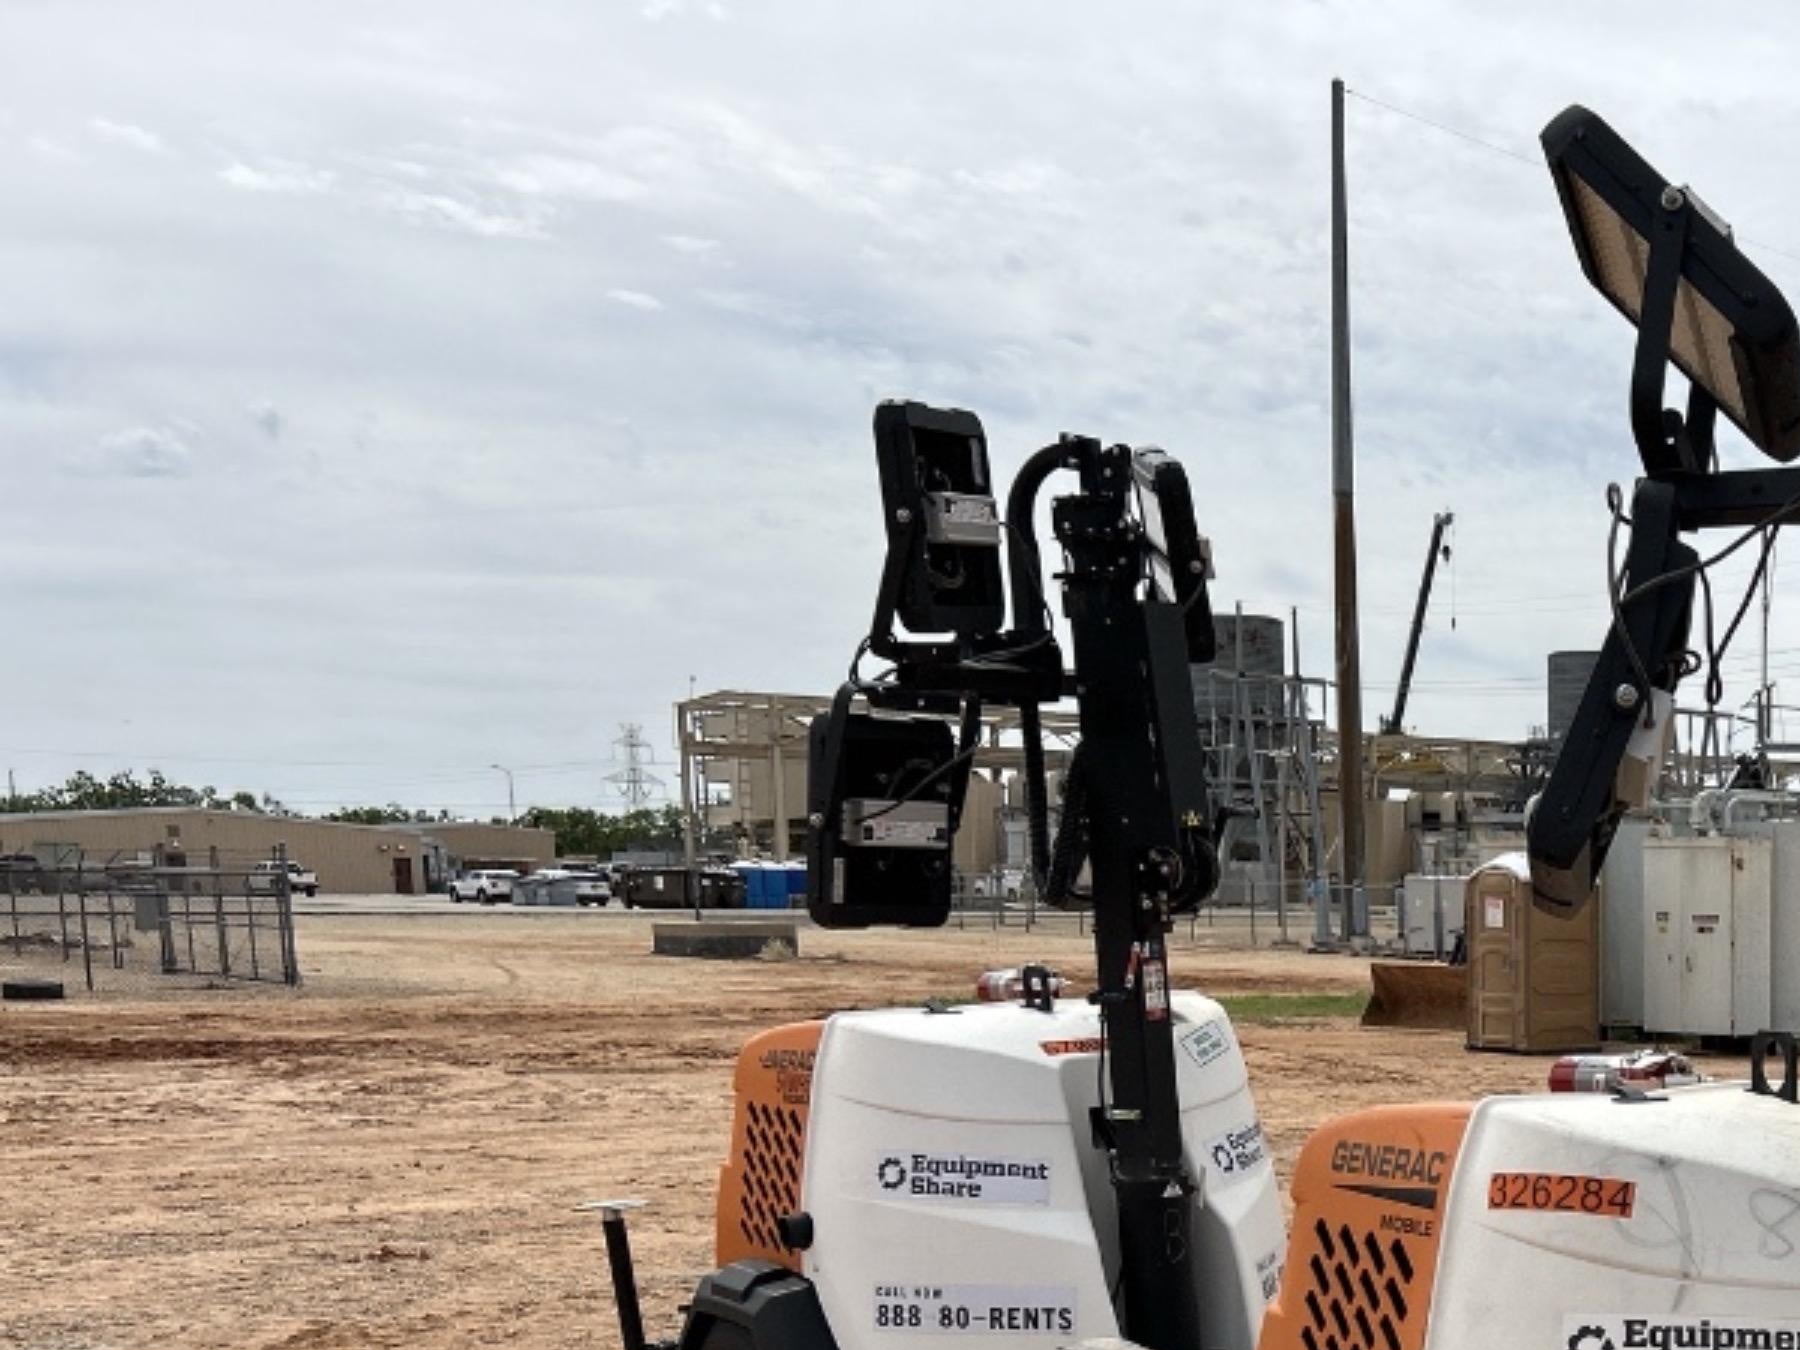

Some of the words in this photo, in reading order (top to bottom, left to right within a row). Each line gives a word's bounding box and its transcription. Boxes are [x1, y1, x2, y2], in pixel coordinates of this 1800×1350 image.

[911, 1154, 1049, 1180] Equipment
[1331, 1140, 1445, 1184] GENERAC
[911, 1176, 982, 1198] Share
[1489, 1173, 1633, 1215] 326284
[1380, 1214, 1432, 1236] MOBILE
[876, 1304, 1073, 1330] 88880-RENTS
